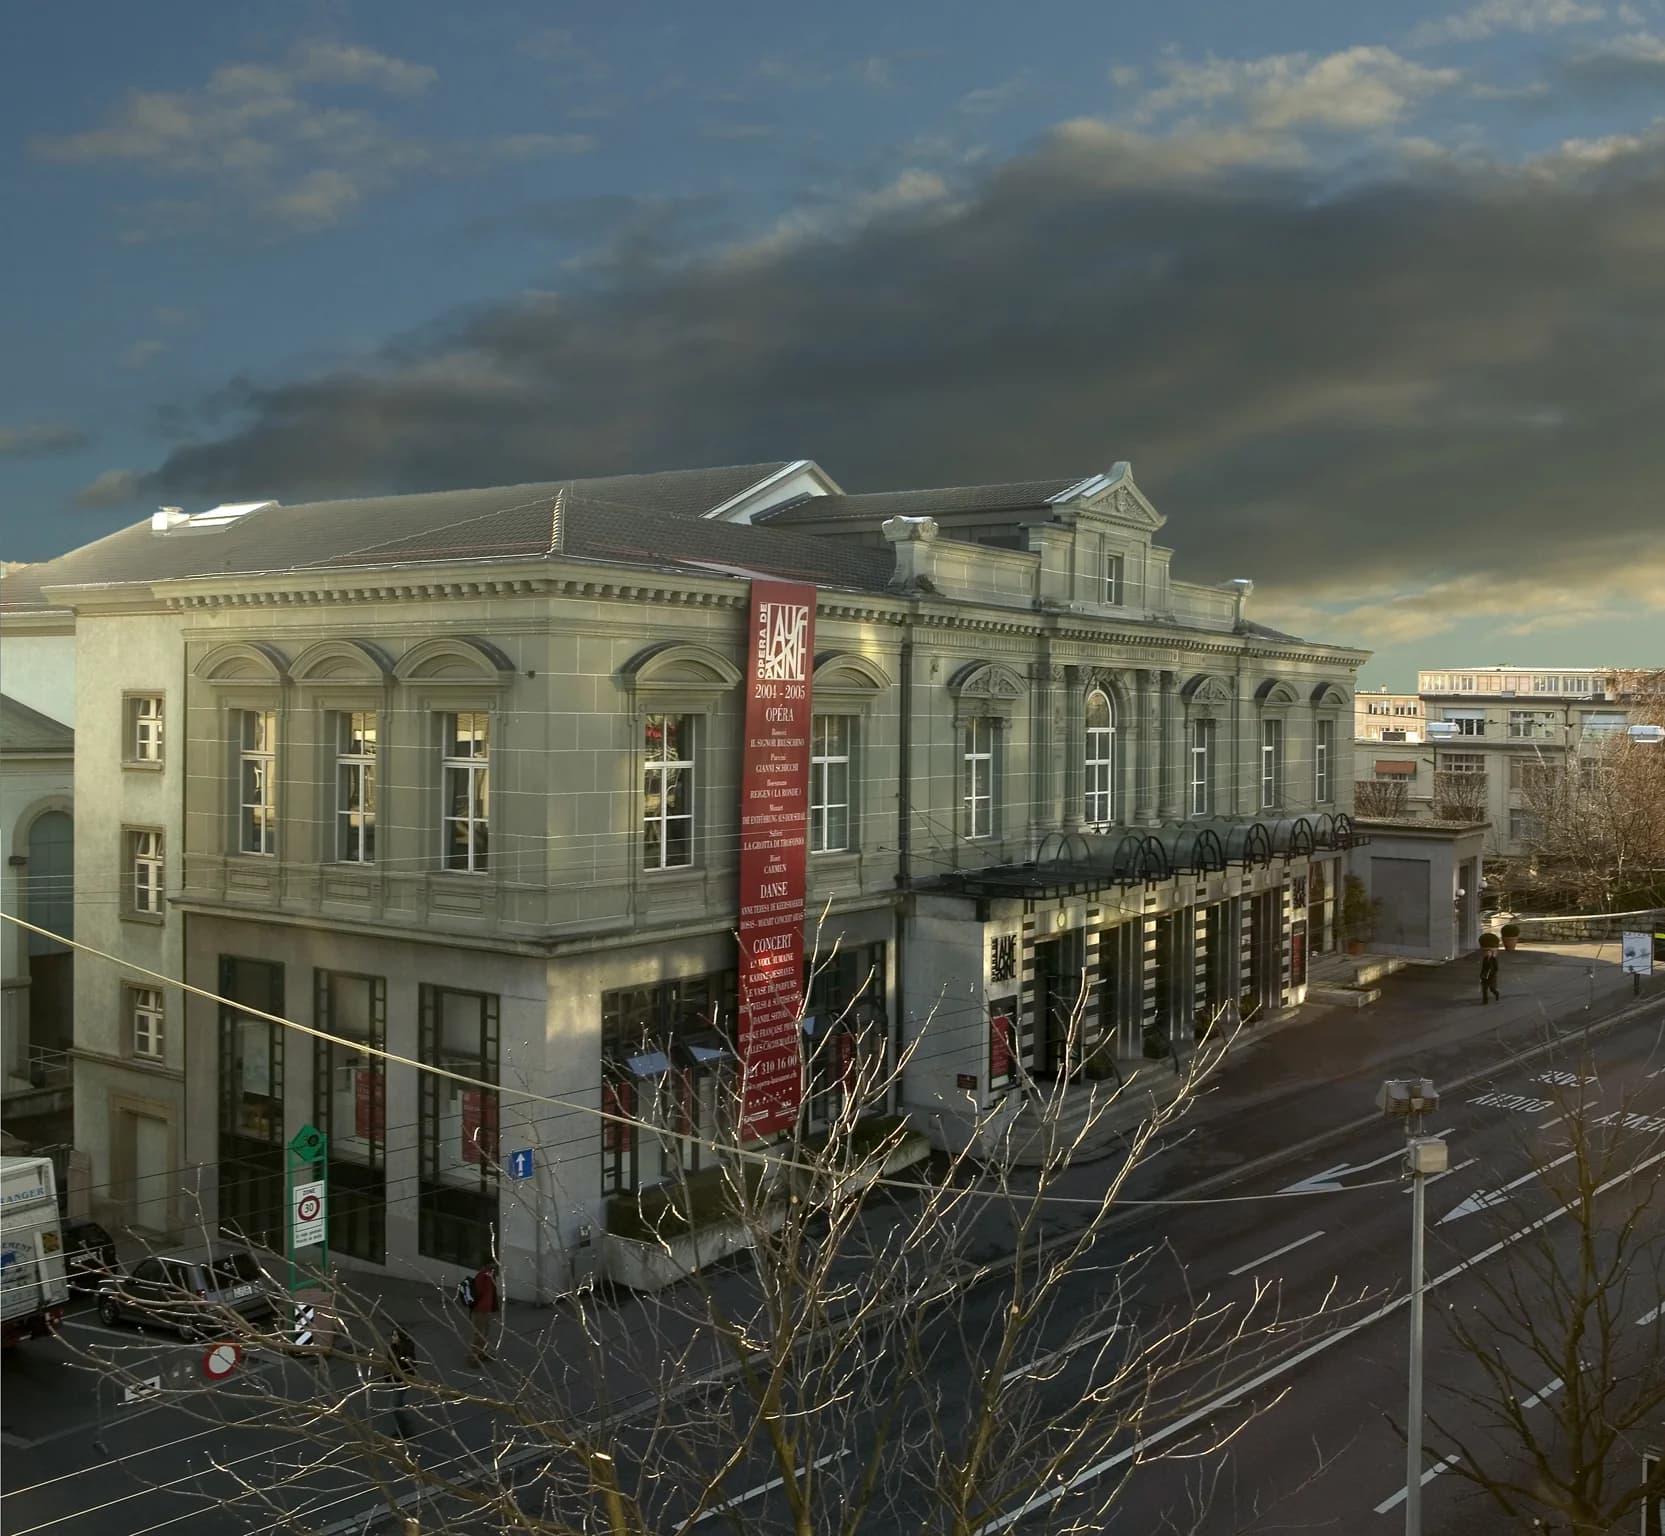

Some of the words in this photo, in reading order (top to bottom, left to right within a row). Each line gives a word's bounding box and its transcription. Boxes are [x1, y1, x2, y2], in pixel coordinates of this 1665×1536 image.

[760, 603, 768, 623] DE
[755, 684, 777, 699] 2004
[785, 685, 806, 700] 2005
[766, 704, 794, 722] OPÉRA
[764, 864, 788, 874] CARMEN
[760, 881, 788, 899] DANSE
[753, 933, 792, 954] CONCERT
[761, 1061, 774, 1075] 310
[777, 1057, 786, 1070] 16
[788, 1055, 797, 1066] 00
[1466, 1093, 1554, 1113] OUCHY
[304, 1202, 314, 1214] 30
